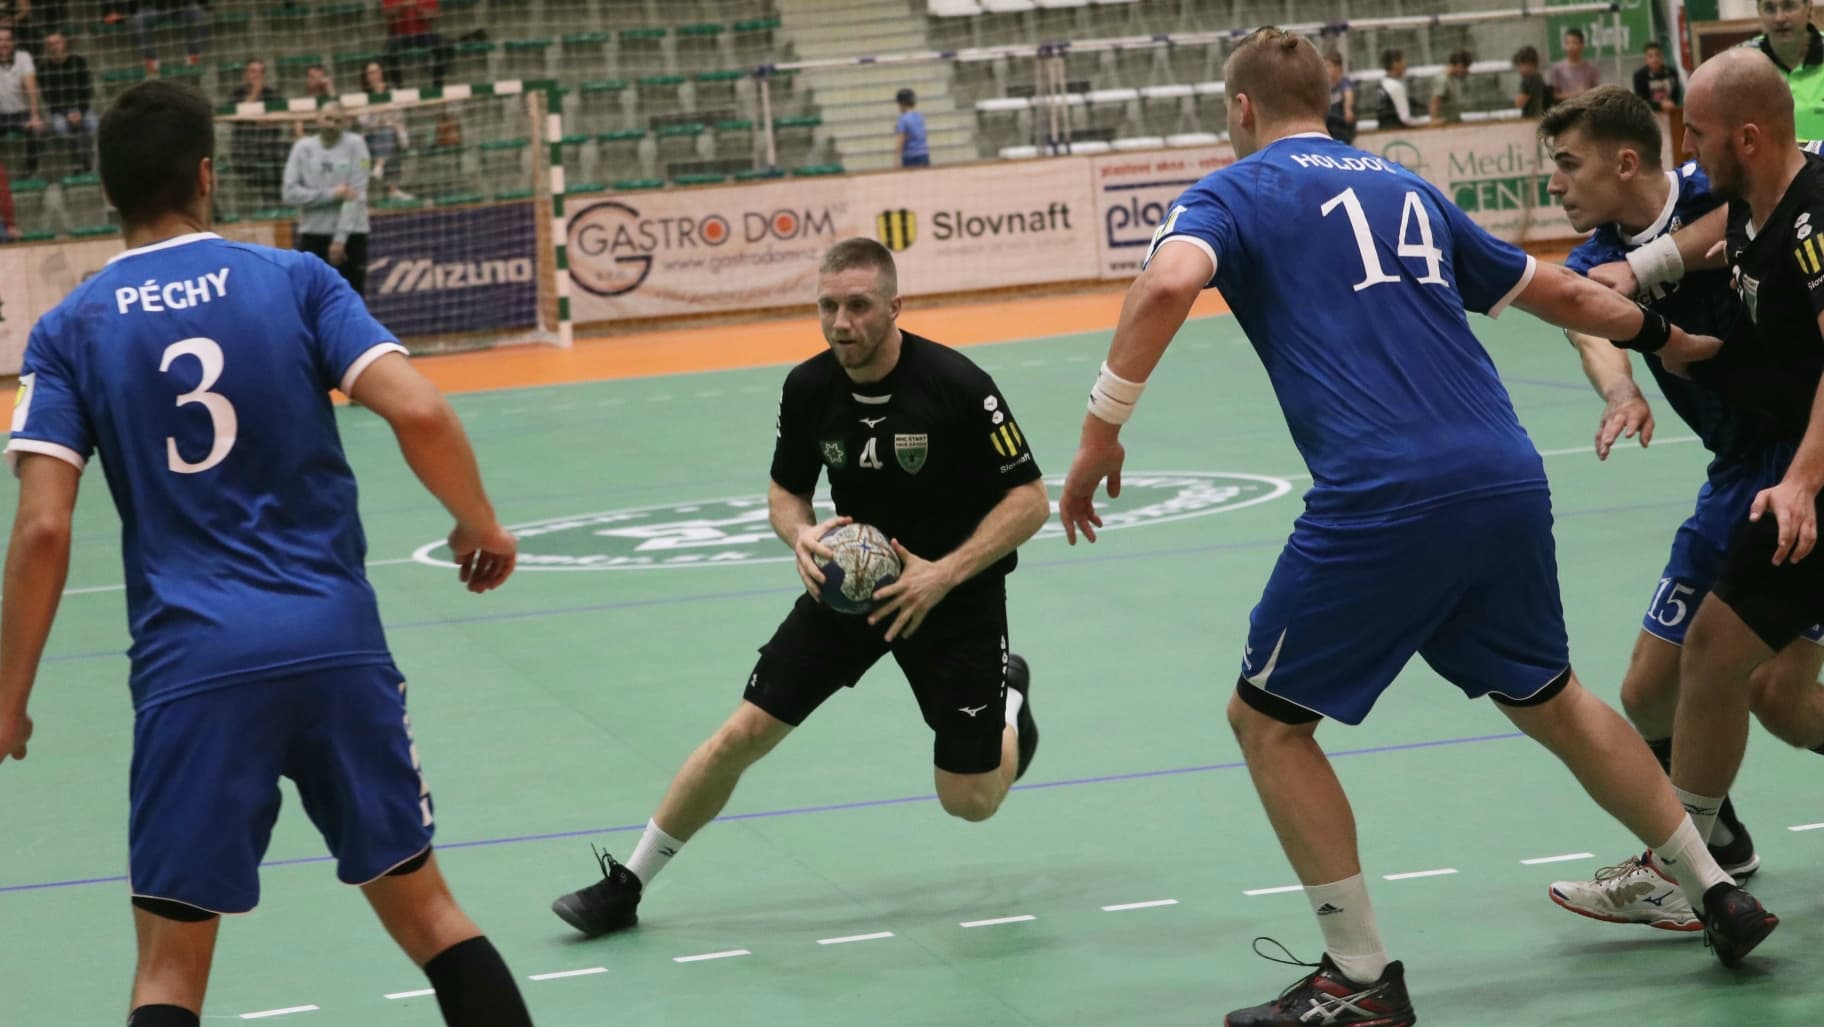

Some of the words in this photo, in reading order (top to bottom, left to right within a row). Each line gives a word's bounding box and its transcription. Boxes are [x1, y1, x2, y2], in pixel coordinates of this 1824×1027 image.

[577, 213, 730, 257] GASTRO
[744, 207, 836, 243] DOM
[932, 203, 1072, 241] Slovnaft
[1320, 187, 1449, 292] 14
[115, 267, 230, 315] PÉCHY
[1808, 273, 1824, 290] Slov
[159, 337, 238, 474] 3
[859, 437, 883, 469] 4
[1648, 576, 1696, 627] 15
